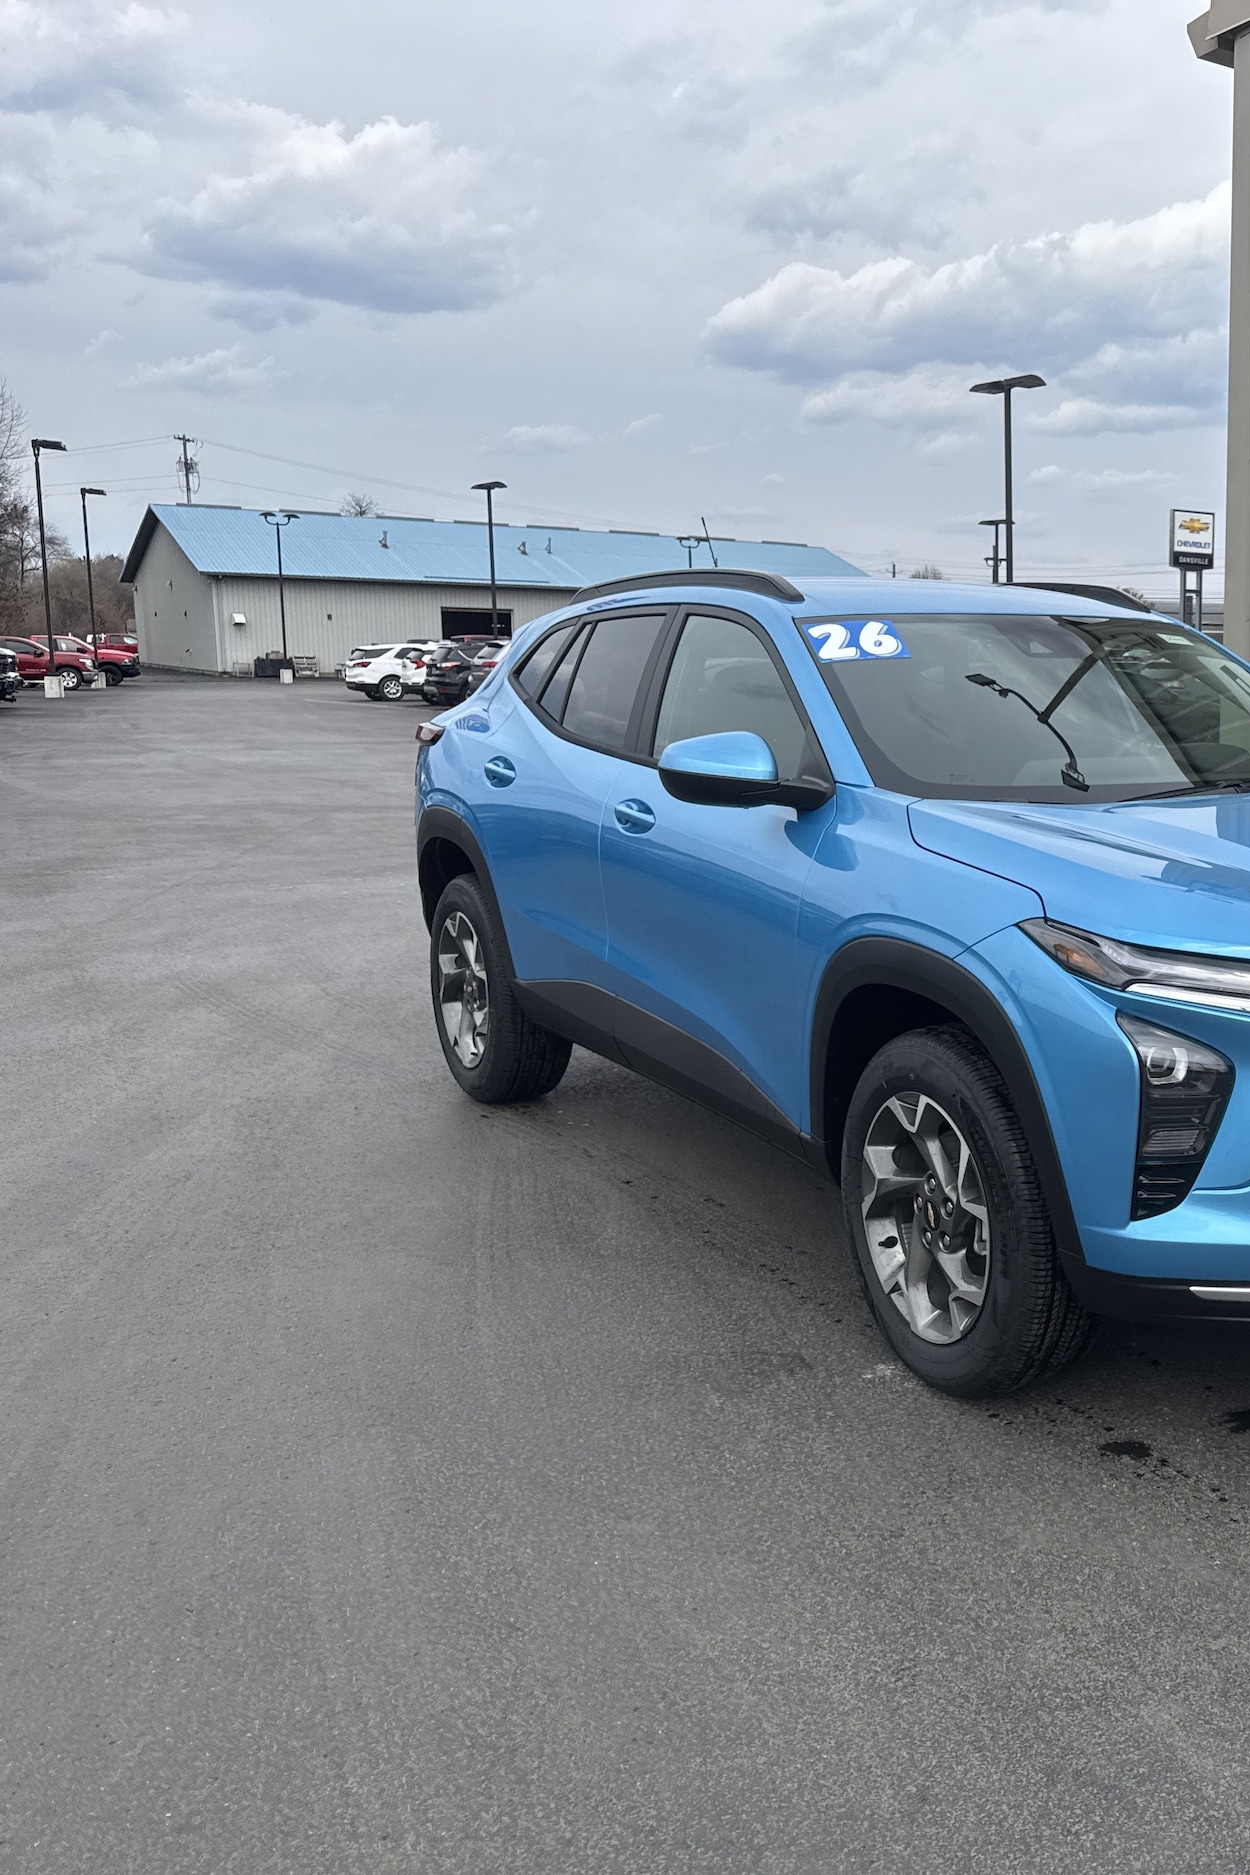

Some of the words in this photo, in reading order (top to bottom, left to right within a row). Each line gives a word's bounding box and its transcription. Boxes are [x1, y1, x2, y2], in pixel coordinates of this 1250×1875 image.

[1176, 540, 1211, 550] CHEVROLET
[1178, 555, 1209, 565] DANSVILLE
[807, 620, 902, 660] 26
